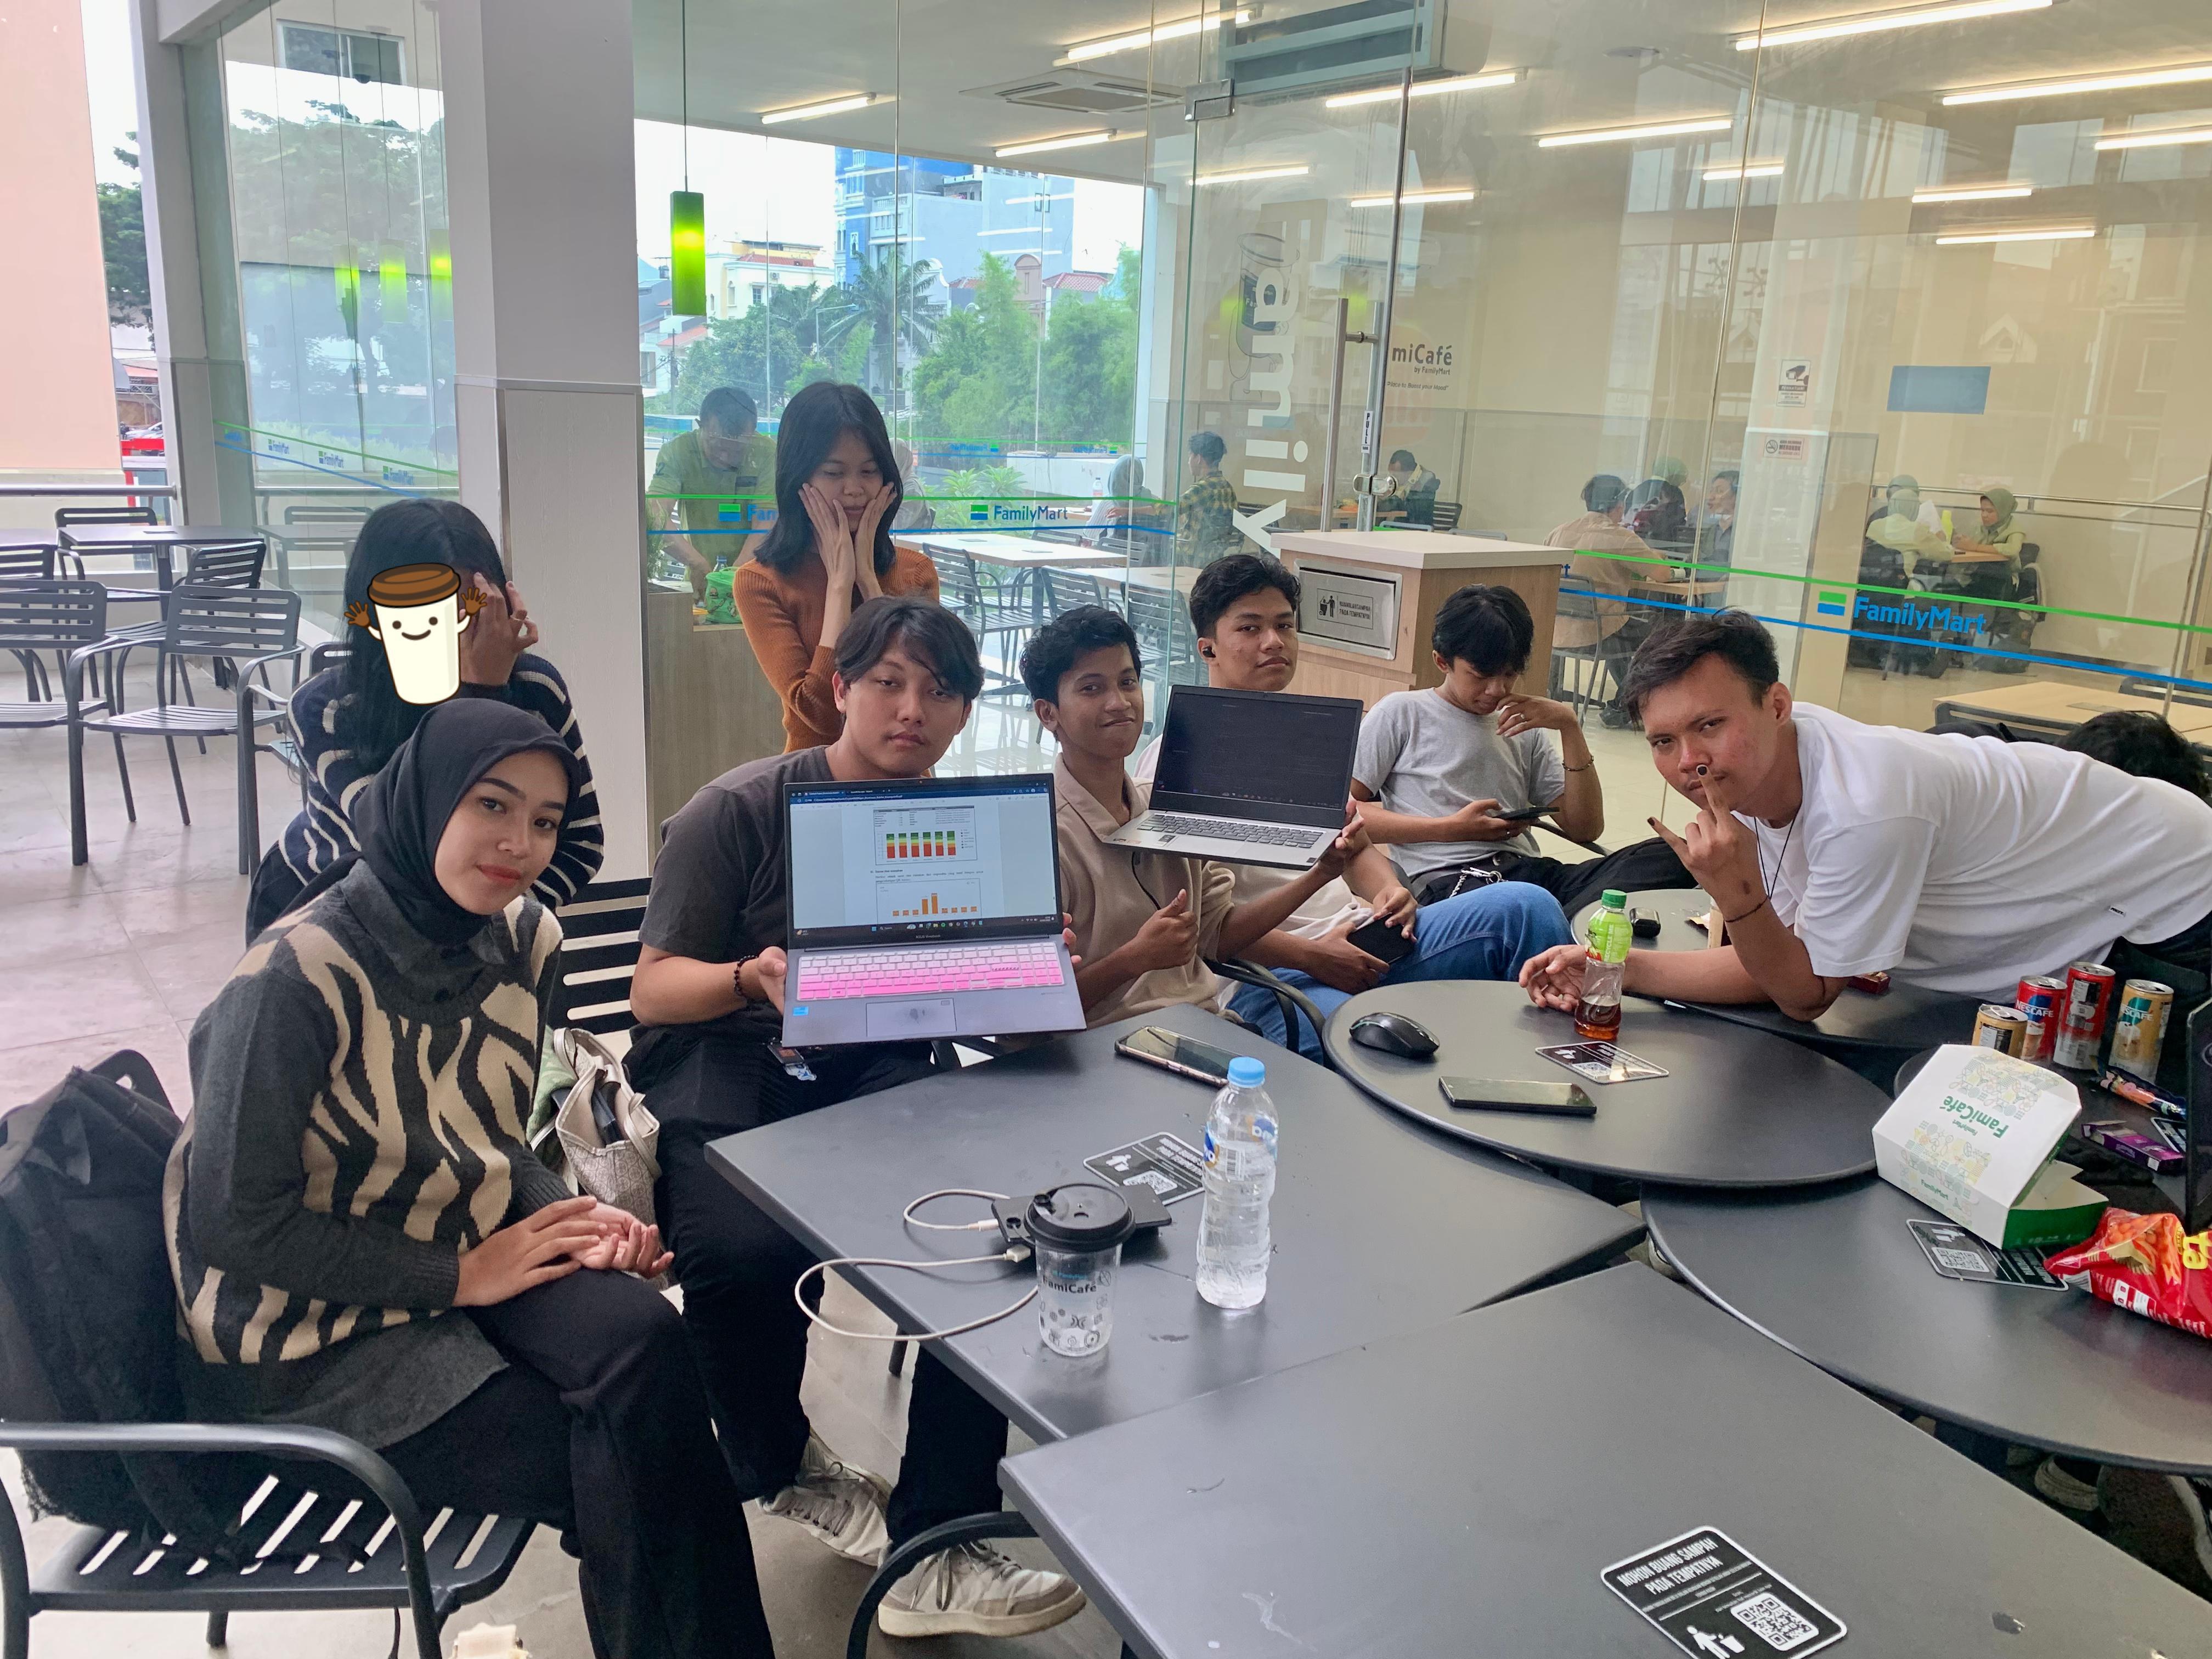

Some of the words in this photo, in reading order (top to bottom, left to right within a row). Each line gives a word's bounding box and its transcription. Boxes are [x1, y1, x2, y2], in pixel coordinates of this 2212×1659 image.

[1422, 366, 1450, 375] FamilyMart
[994, 505, 1068, 522] FamilyMart
[1853, 596, 1987, 635] FamilyMart
[1608, 924, 1614, 934] ME
[1604, 935, 1613, 962] RECYCLE
[1939, 1096, 2009, 1138] FamiCafé
[1617, 1565, 1656, 1587] MOHON
[1648, 1552, 1684, 1573] BUANG
[1677, 1537, 1719, 1561] SAMPAH
[1645, 1576, 1675, 1595] PADA
[1667, 1555, 1724, 1584] TEMPATNYA
